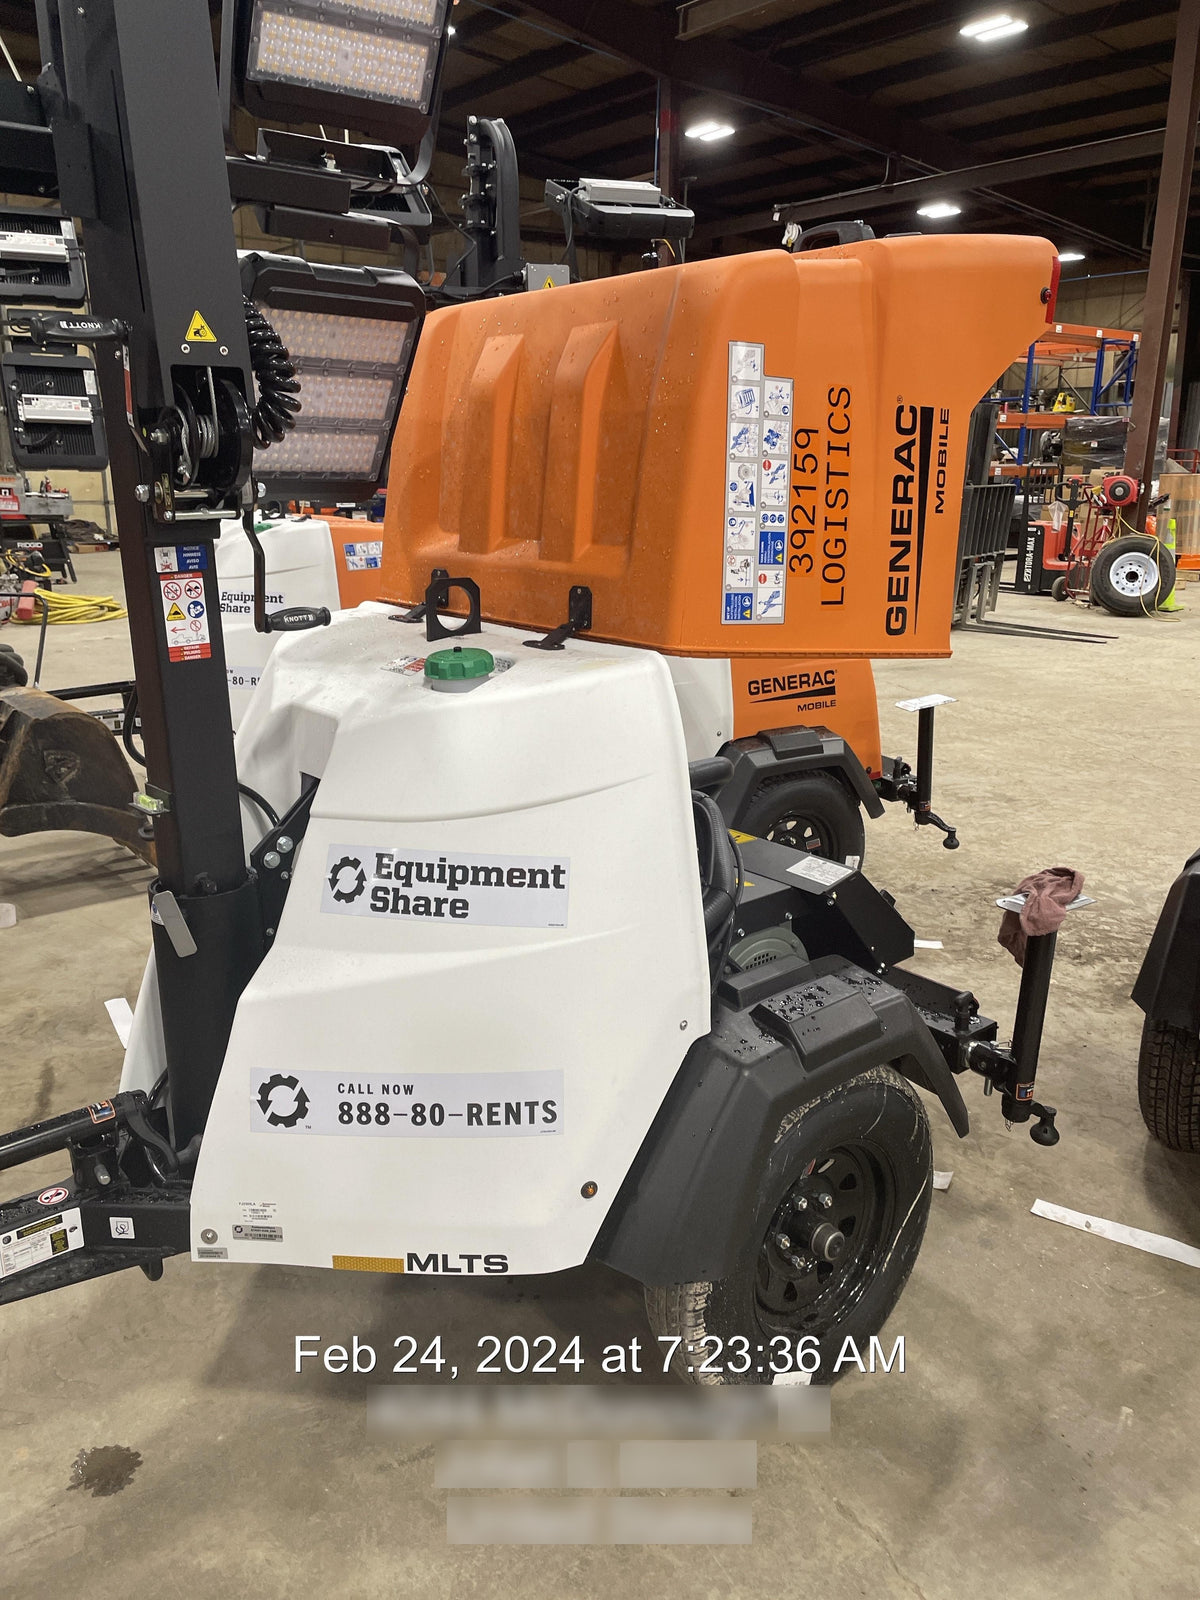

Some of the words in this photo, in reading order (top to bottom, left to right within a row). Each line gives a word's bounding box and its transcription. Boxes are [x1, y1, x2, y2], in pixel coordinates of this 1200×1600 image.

[935, 407, 950, 514] MOBILE
[788, 428, 819, 575] 392159
[821, 386, 851, 606] LOGISTICS
[886, 404, 918, 636] GENERAC
[748, 670, 836, 696] GENERAC
[797, 700, 837, 712] MOBILE
[373, 852, 566, 891] Equipment
[369, 885, 469, 919] Share
[337, 1082, 374, 1095] CALL
[381, 1083, 415, 1096] NOW
[406, 1252, 509, 1274] MLTS
